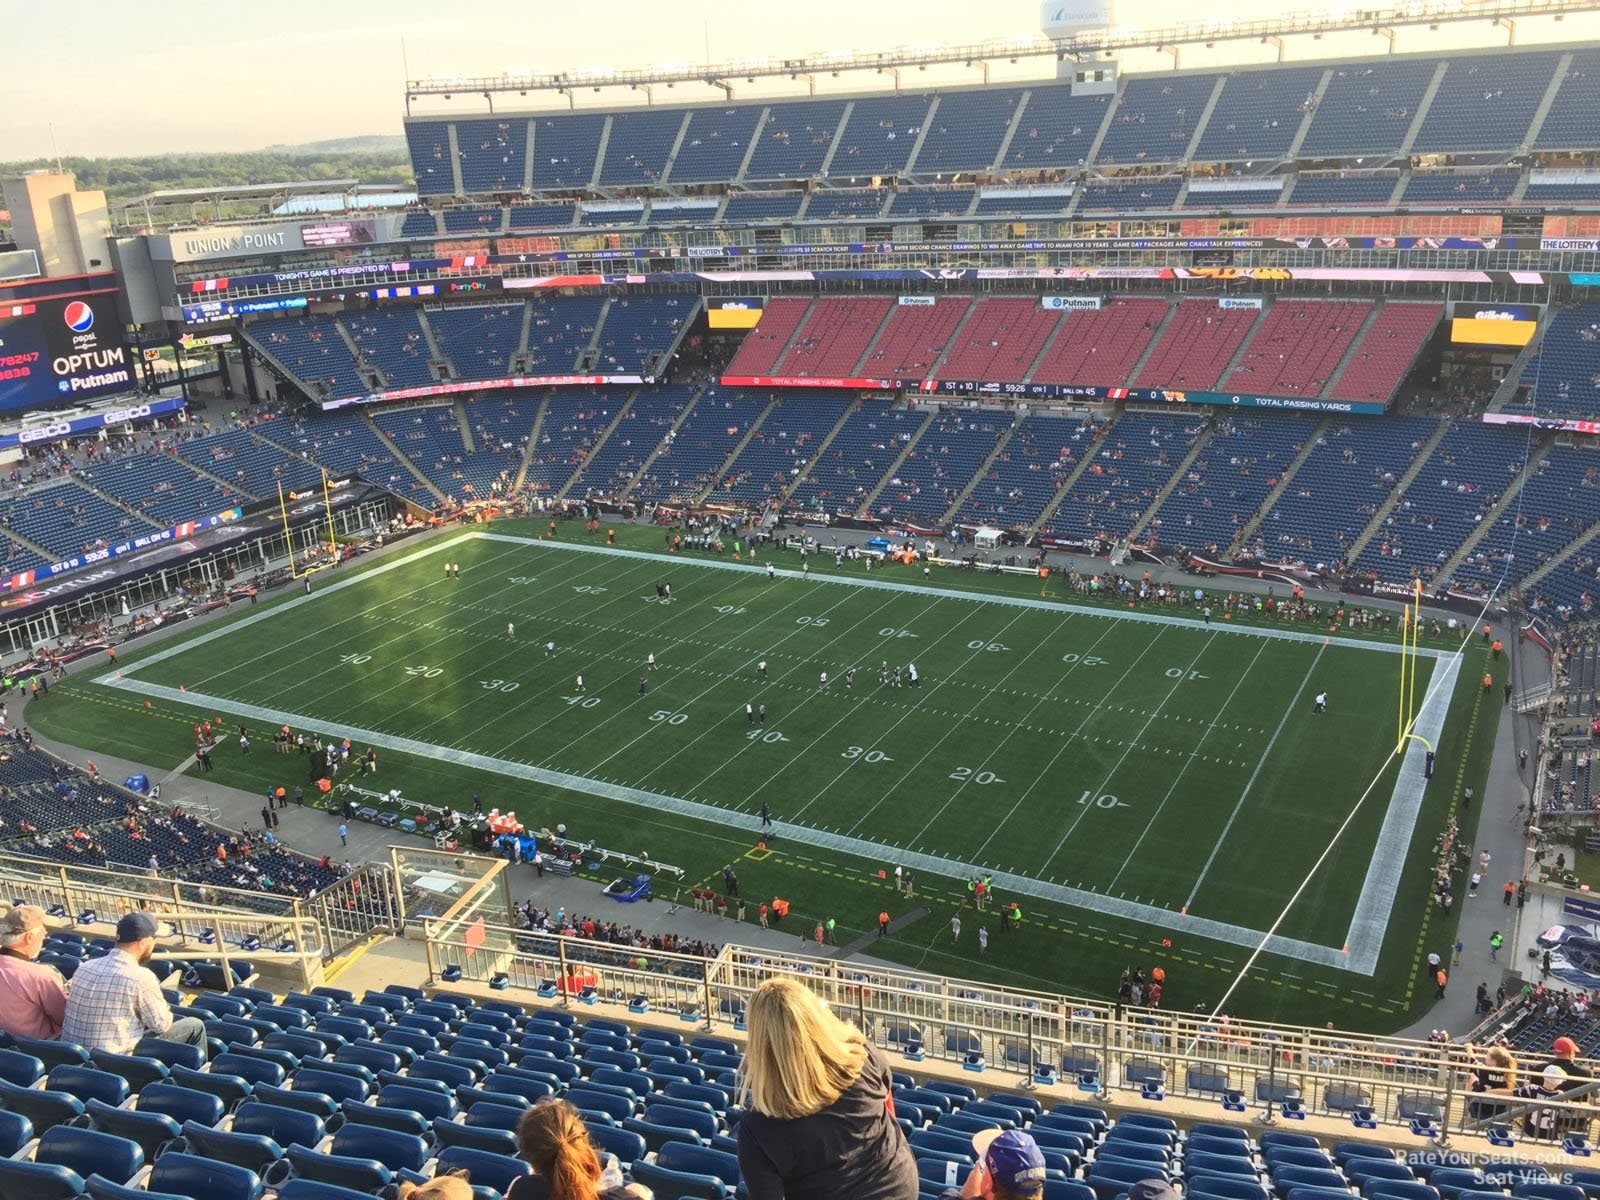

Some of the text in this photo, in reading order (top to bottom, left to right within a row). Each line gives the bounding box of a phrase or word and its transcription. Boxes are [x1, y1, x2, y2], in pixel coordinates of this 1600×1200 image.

[187, 238, 230, 255] UNION
[243, 232, 285, 248] POINT
[1542, 240, 1596, 249] THE LOTTERY
[699, 248, 722, 256] LOTTERY
[274, 271, 309, 281] TONIGHT'S
[310, 269, 330, 278] GAME
[338, 265, 377, 276] PRESENTED
[249, 302, 279, 310] Putnam
[1062, 299, 1096, 307] Putnam
[72, 332, 97, 345] pepsi
[53, 347, 124, 375] OPTUM
[70, 370, 129, 391] Putnam
[896, 380, 901, 388] 0
[945, 381, 956, 390] 1ST
[965, 382, 973, 390] 10
[1005, 384, 1026, 393] 59:26
[1085, 387, 1096, 396] 45
[1150, 391, 1157, 399] 0
[1232, 396, 1352, 411] 0 TOTAL PASSING YARDS
[104, 405, 151, 424] GEICO
[19, 422, 72, 443] GEICO
[210, 516, 217, 525] 0
[50, 563, 63, 573] 1ST
[70, 558, 78, 568] 10
[84, 549, 109, 563] 59:26
[135, 536, 151, 547] BALL
[152, 534, 161, 543] ON
[161, 530, 170, 539] 45
[30, 568, 117, 598] OPTUM
[796, 616, 830, 627] 50
[967, 640, 1004, 652] 30
[343, 653, 372, 665] 10
[1062, 653, 1102, 666] 20
[408, 665, 444, 678] 20
[483, 679, 520, 693] 30
[567, 694, 602, 708] 40
[648, 709, 689, 725] 50
[746, 728, 783, 743] 40
[840, 746, 886, 763] 30
[948, 766, 998, 784] 20
[1075, 790, 1120, 809] 10
